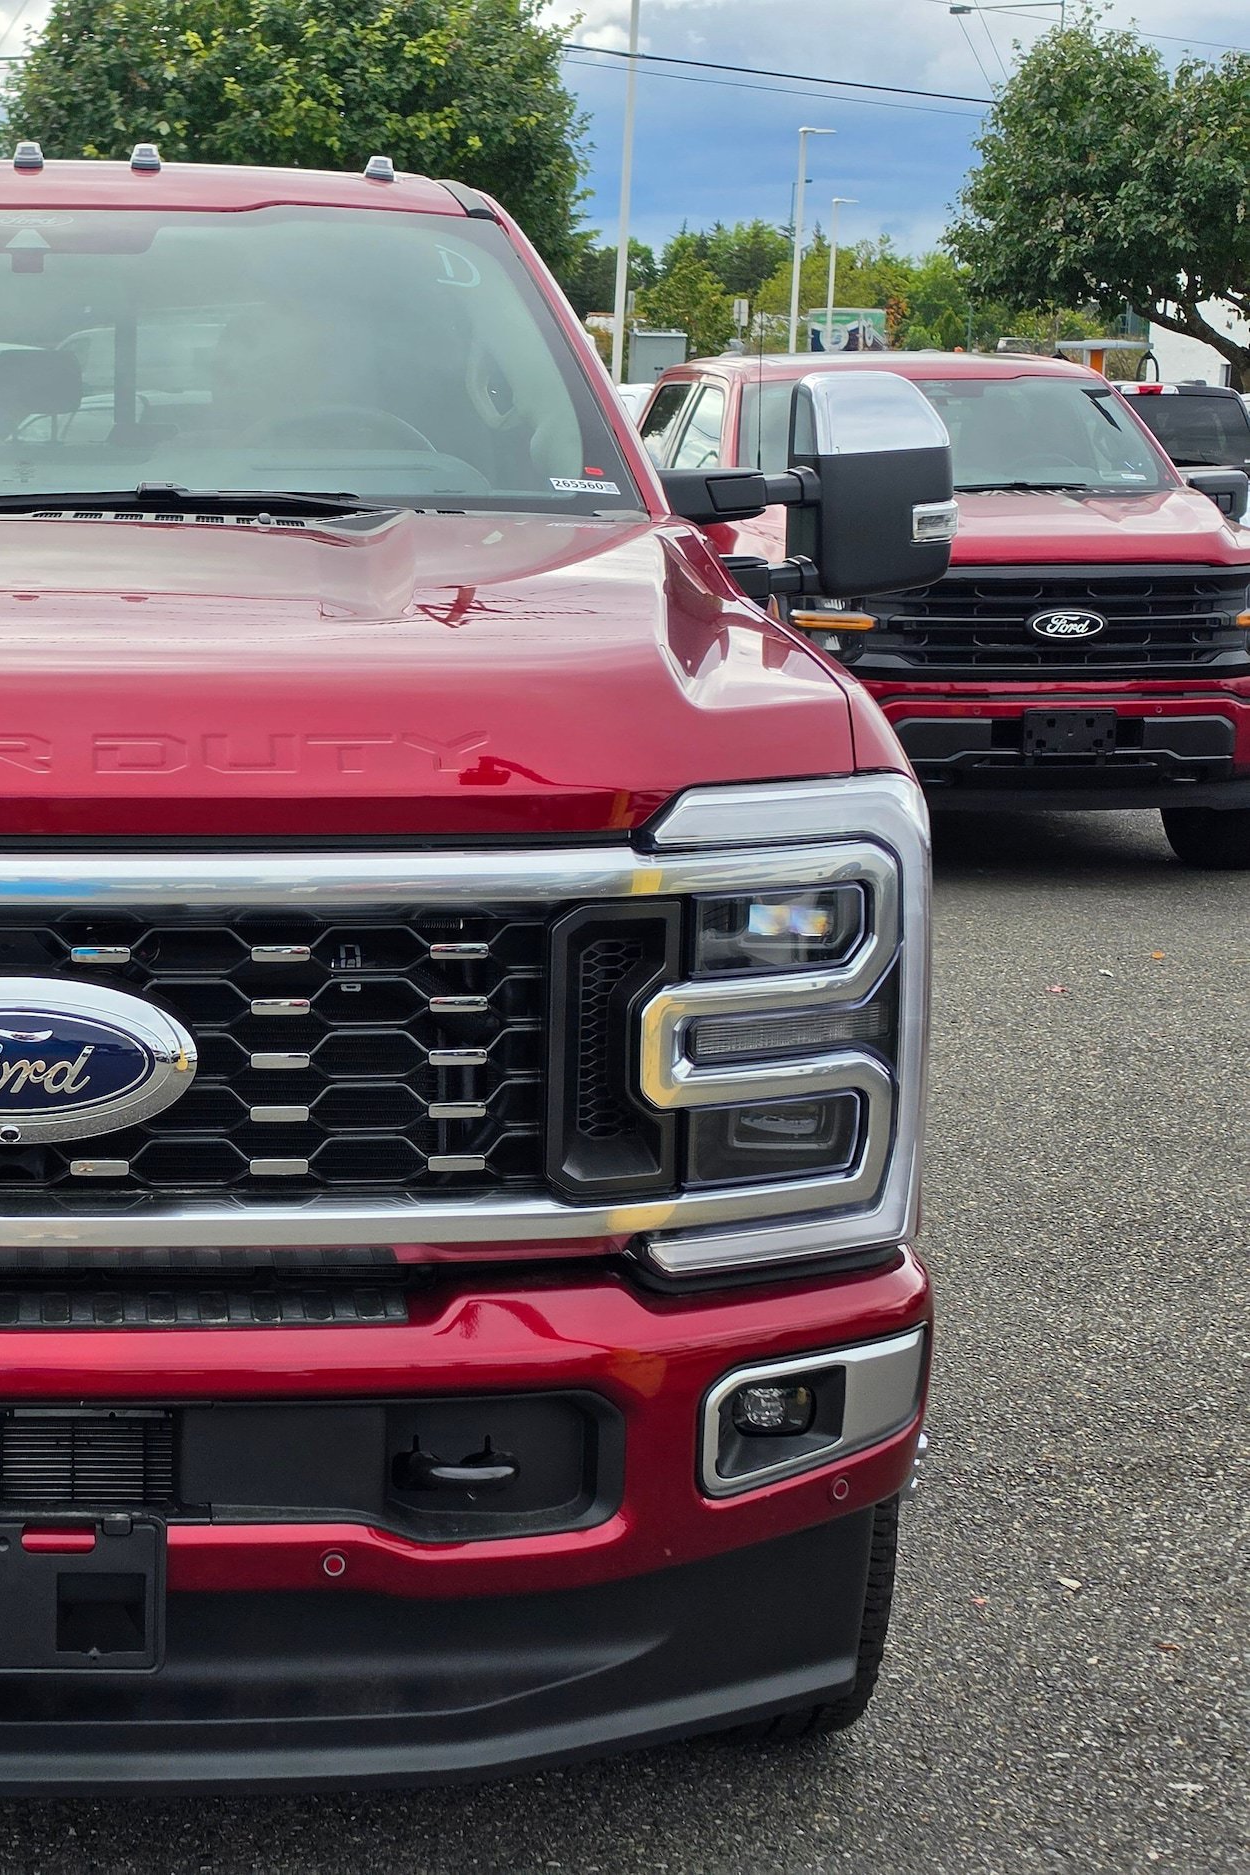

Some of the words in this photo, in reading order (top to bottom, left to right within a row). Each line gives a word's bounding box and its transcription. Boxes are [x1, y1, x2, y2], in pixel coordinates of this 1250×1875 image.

[553, 479, 604, 490] 265560
[1046, 615, 1090, 634] Ford
[91, 730, 489, 775] DUTY
